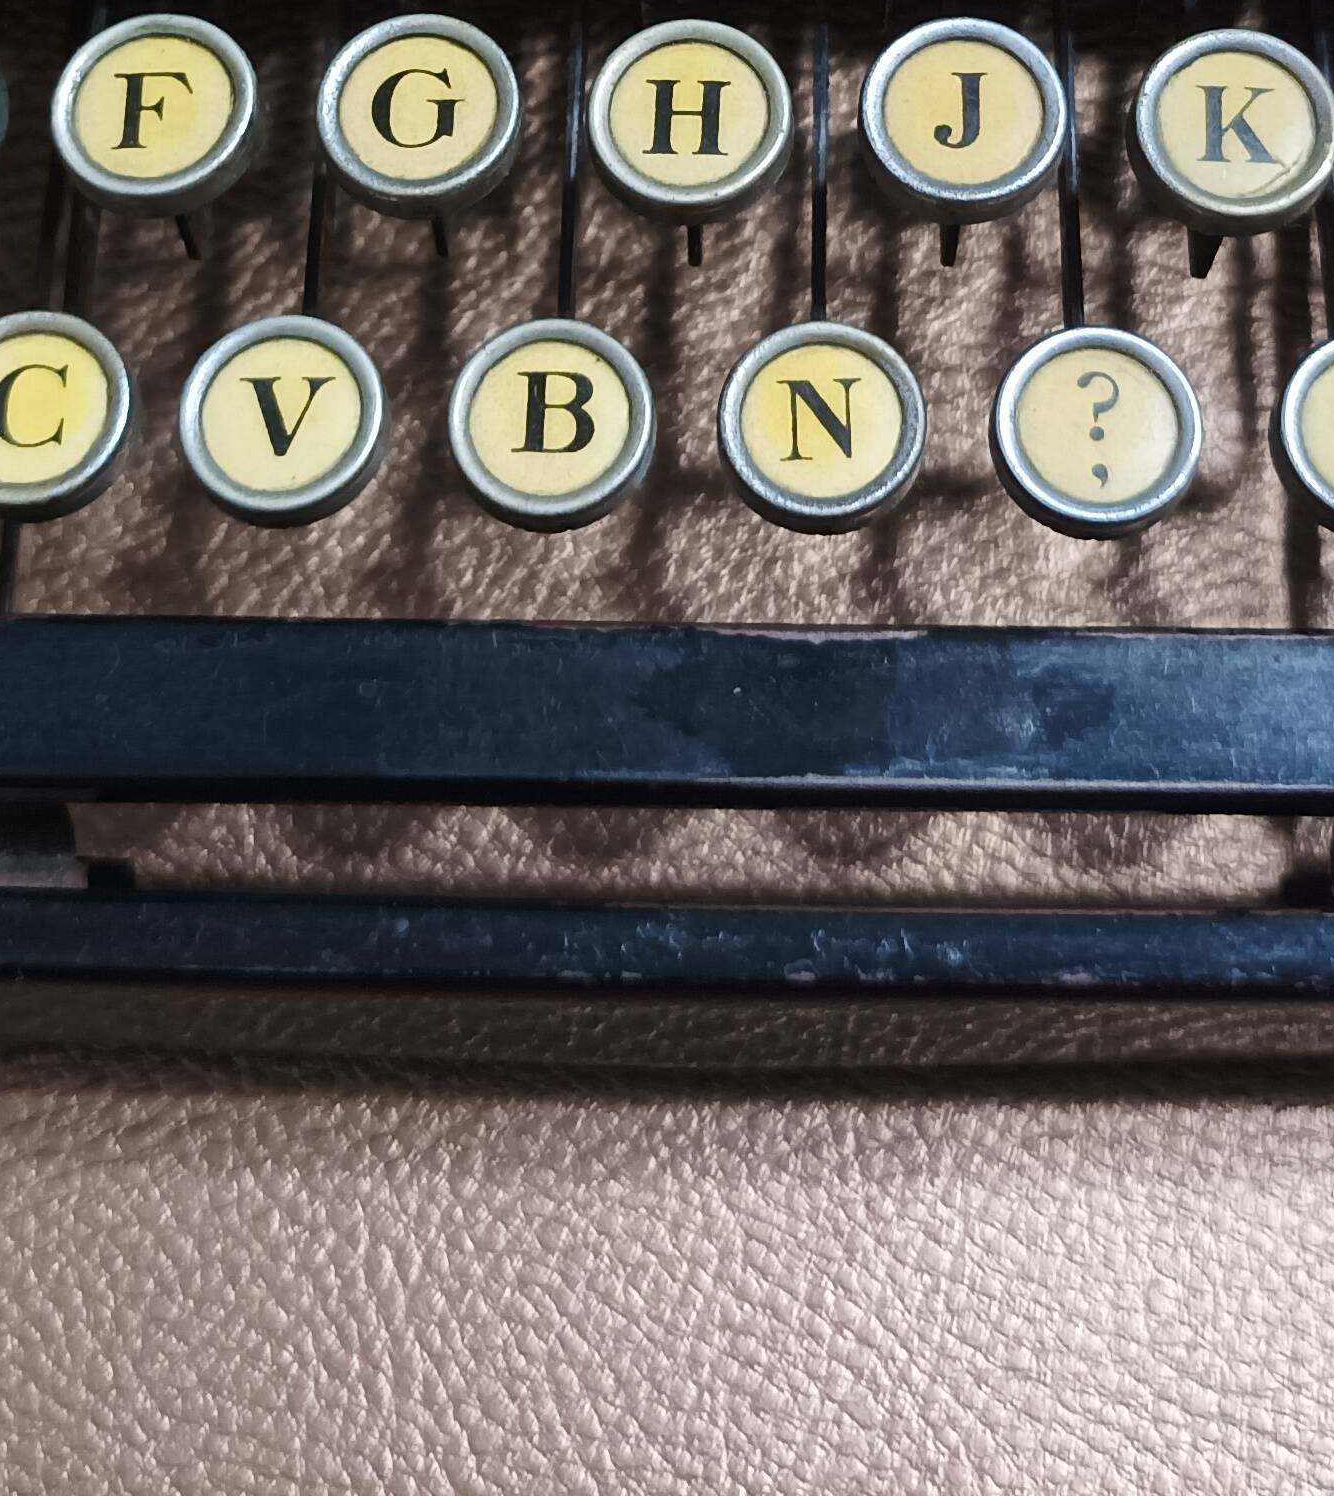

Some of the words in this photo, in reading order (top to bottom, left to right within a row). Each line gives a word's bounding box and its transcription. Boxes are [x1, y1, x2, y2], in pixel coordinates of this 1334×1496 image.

[112, 72, 193, 149] F
[372, 68, 464, 148] G
[643, 80, 731, 155] H
[934, 72, 987, 148] J
[1196, 85, 1283, 166] K
[240, 377, 335, 456] V
[511, 372, 595, 453] B
[777, 378, 861, 461] N
[1077, 371, 1119, 441] ?
